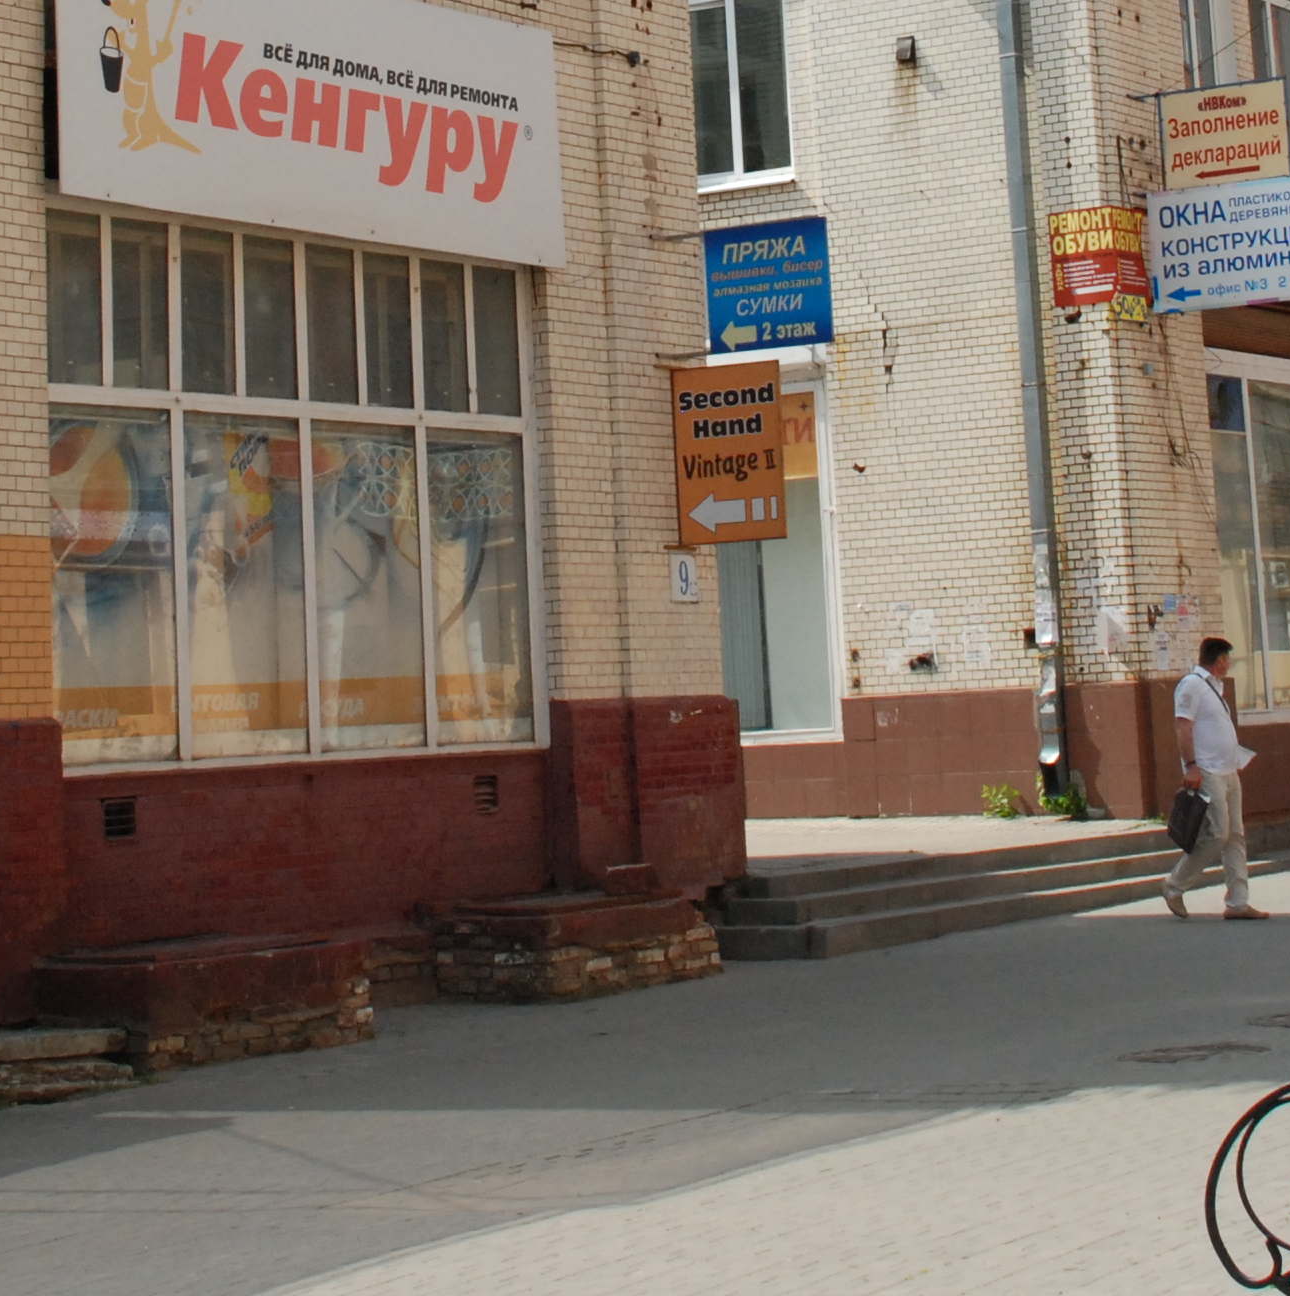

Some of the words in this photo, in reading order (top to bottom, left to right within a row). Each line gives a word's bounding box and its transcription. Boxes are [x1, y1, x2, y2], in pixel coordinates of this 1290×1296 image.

[263, 43, 294, 64] ВСЁ
[295, 50, 330, 72] ДЛЯ
[332, 58, 383, 85] ДОМА,
[386, 69, 414, 90] ВСЁ
[416, 77, 448, 96] ДЛЯ
[450, 83, 519, 113] РЕМОНТА
[174, 31, 519, 204] Кенгуру
[1167, 109, 1280, 139] Заполнение
[1171, 134, 1282, 172] деклараций
[1049, 207, 1112, 236] РЕМОНТ
[1159, 199, 1227, 230] ОКНА
[722, 235, 806, 265] ПРЯЖА
[1052, 228, 1114, 256] ОБУВИ
[782, 259, 824, 274] бисер
[713, 282, 771, 298] алмазная
[773, 276, 823, 291] мозаика
[1207, 282, 1241, 298] офис
[1278, 275, 1287, 288] 2
[736, 292, 804, 317] СУМКИ
[762, 321, 773, 341] 2
[776, 321, 817, 339] этаж
[678, 382, 775, 412] Second
[693, 413, 763, 440] Hand
[681, 451, 759, 482] Vintage
